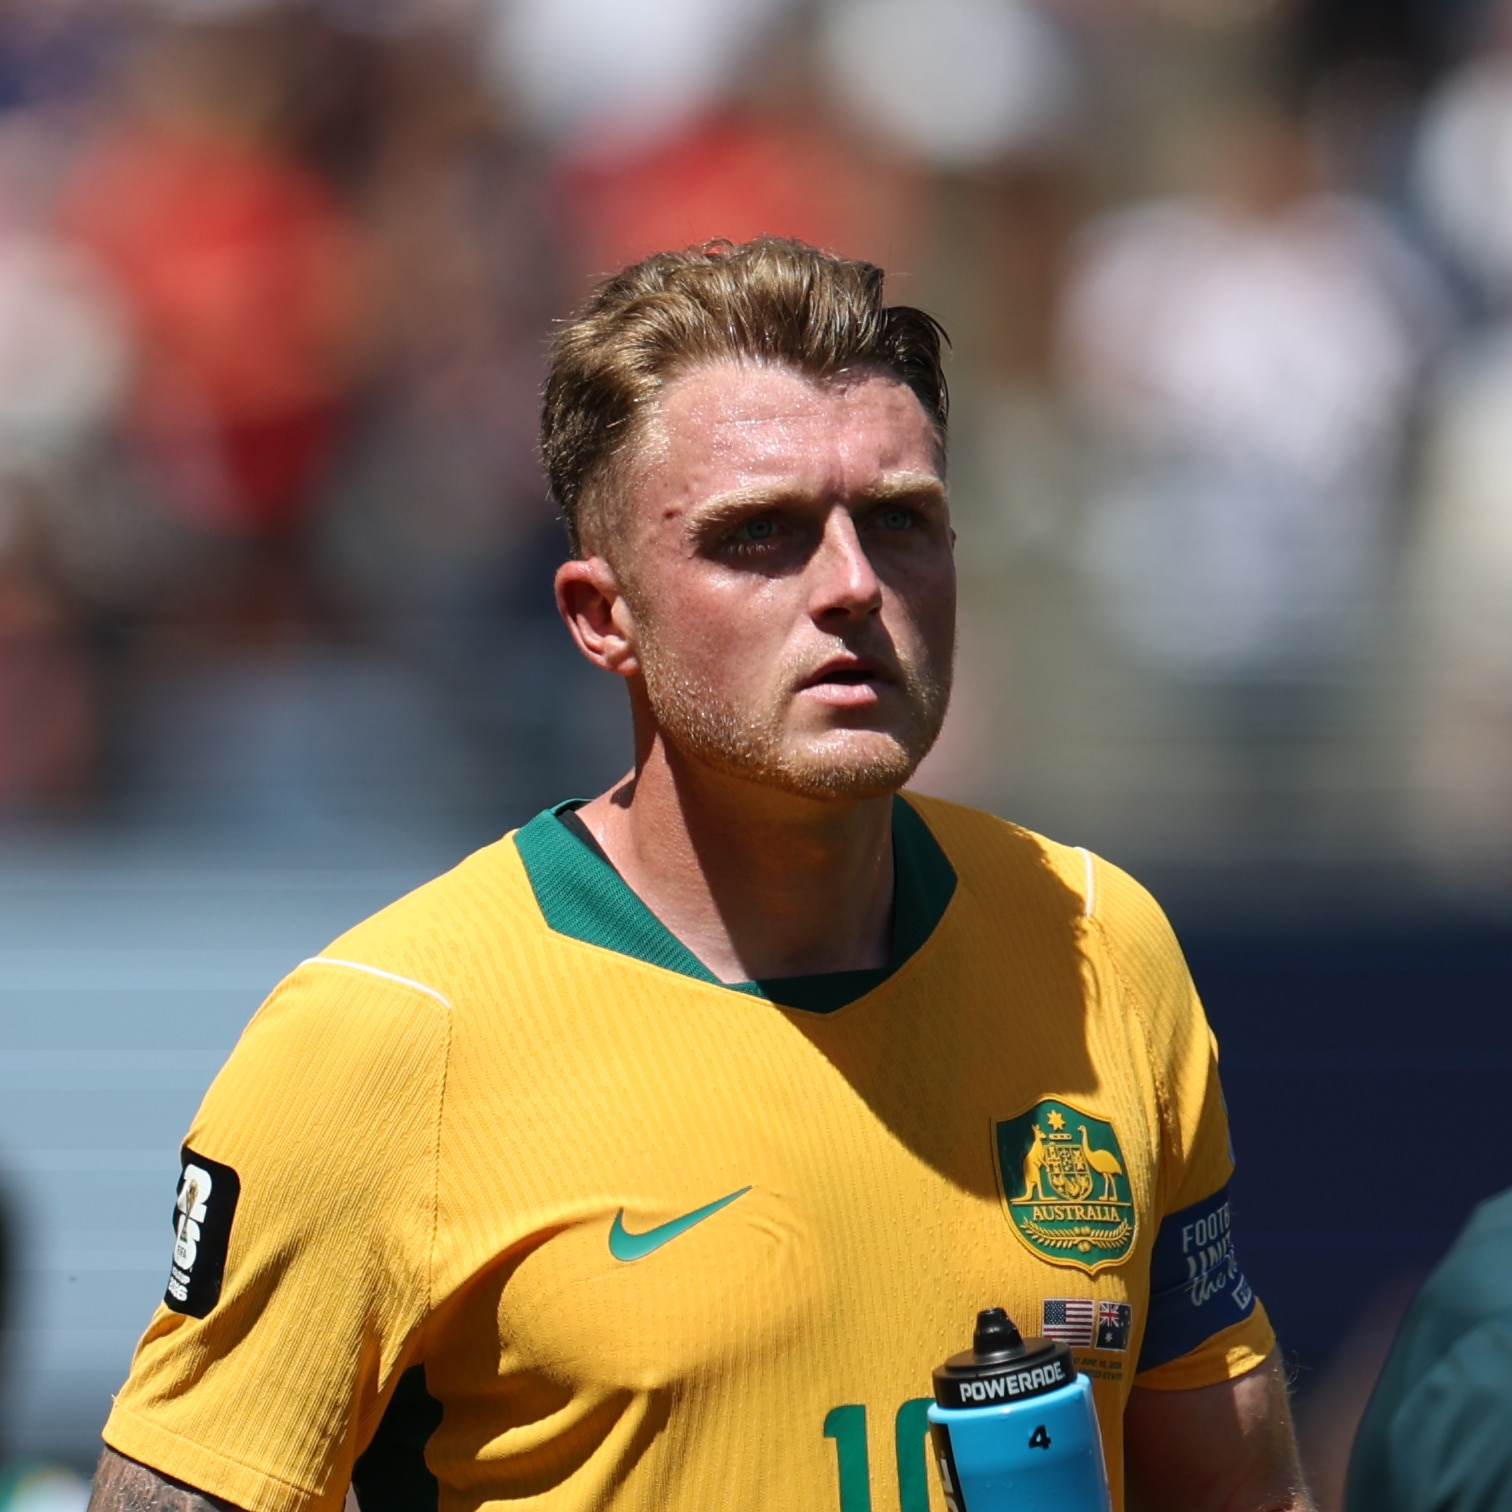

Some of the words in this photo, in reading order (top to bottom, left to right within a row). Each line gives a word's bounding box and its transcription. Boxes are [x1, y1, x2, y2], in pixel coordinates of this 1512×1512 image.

[1033, 1205, 1121, 1221] AUSTRALIA
[960, 1361, 1063, 1402] POWERADE
[1029, 1425, 1051, 1450] 4
